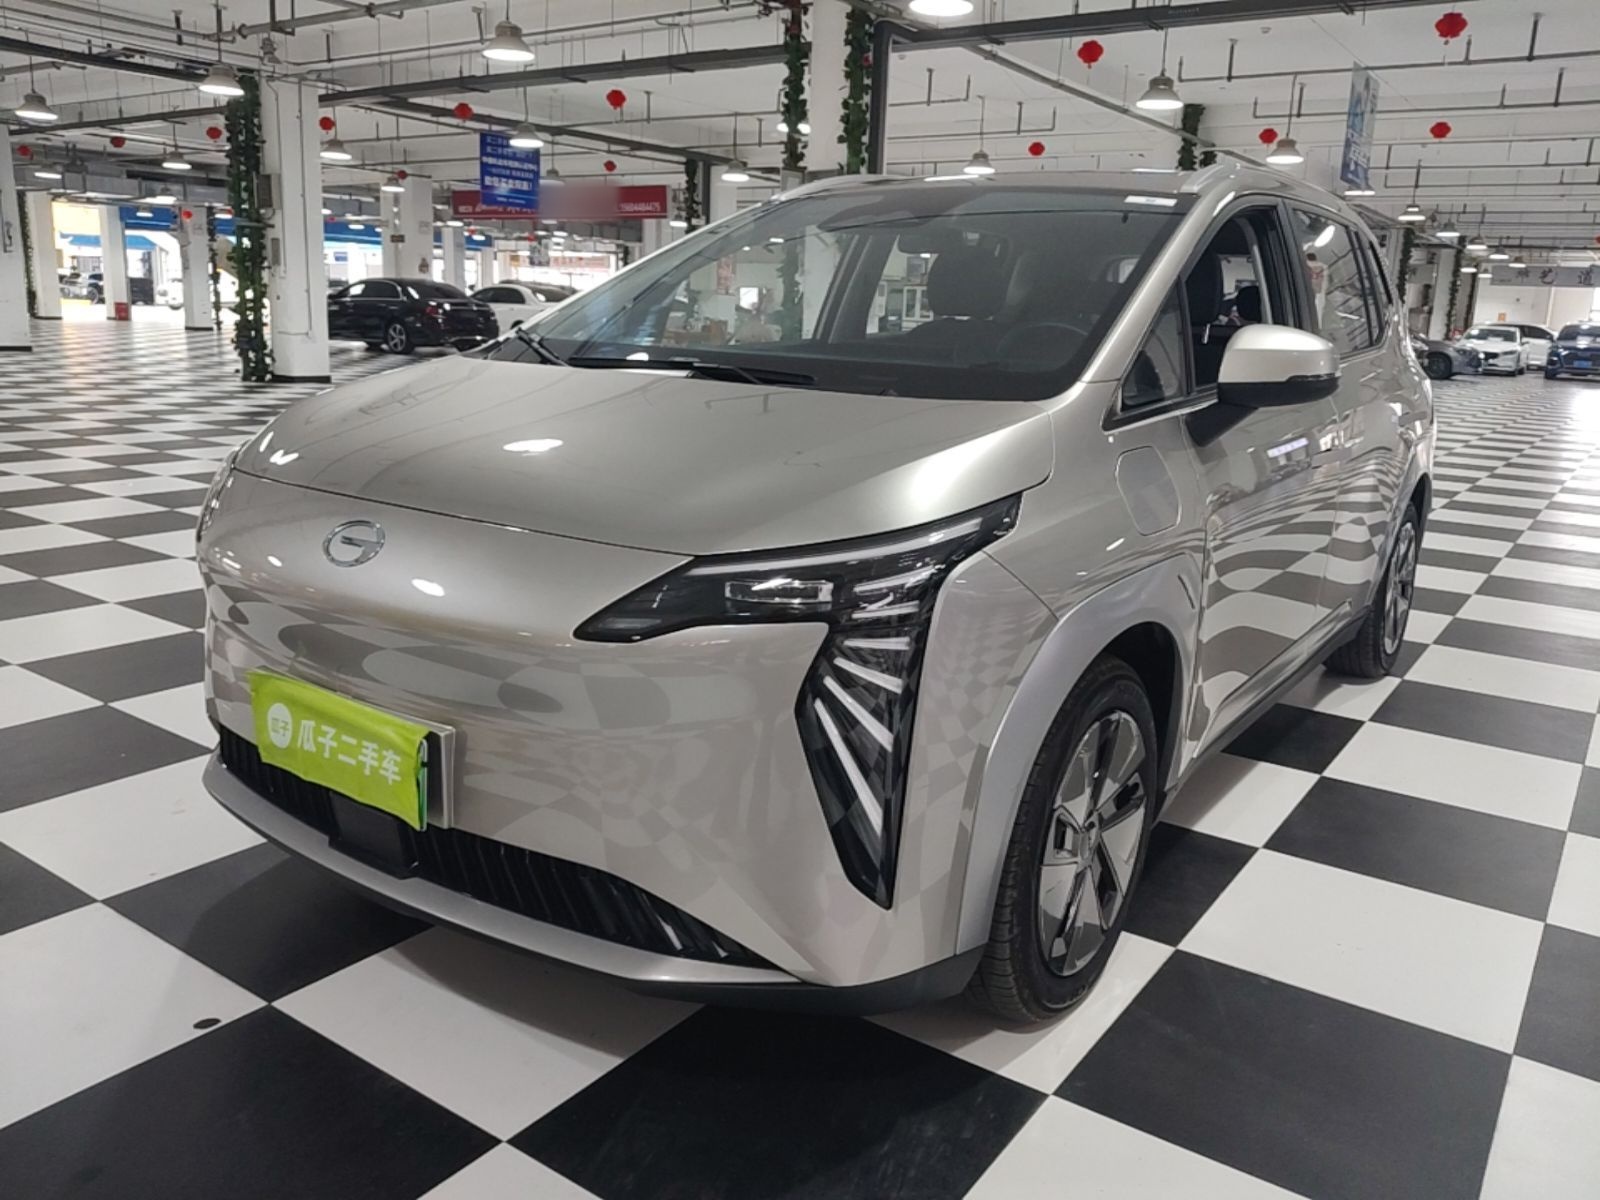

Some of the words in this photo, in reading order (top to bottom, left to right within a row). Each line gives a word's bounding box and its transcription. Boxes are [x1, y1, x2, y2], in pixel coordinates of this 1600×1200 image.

[298, 720, 402, 785] 瓜子二手车
